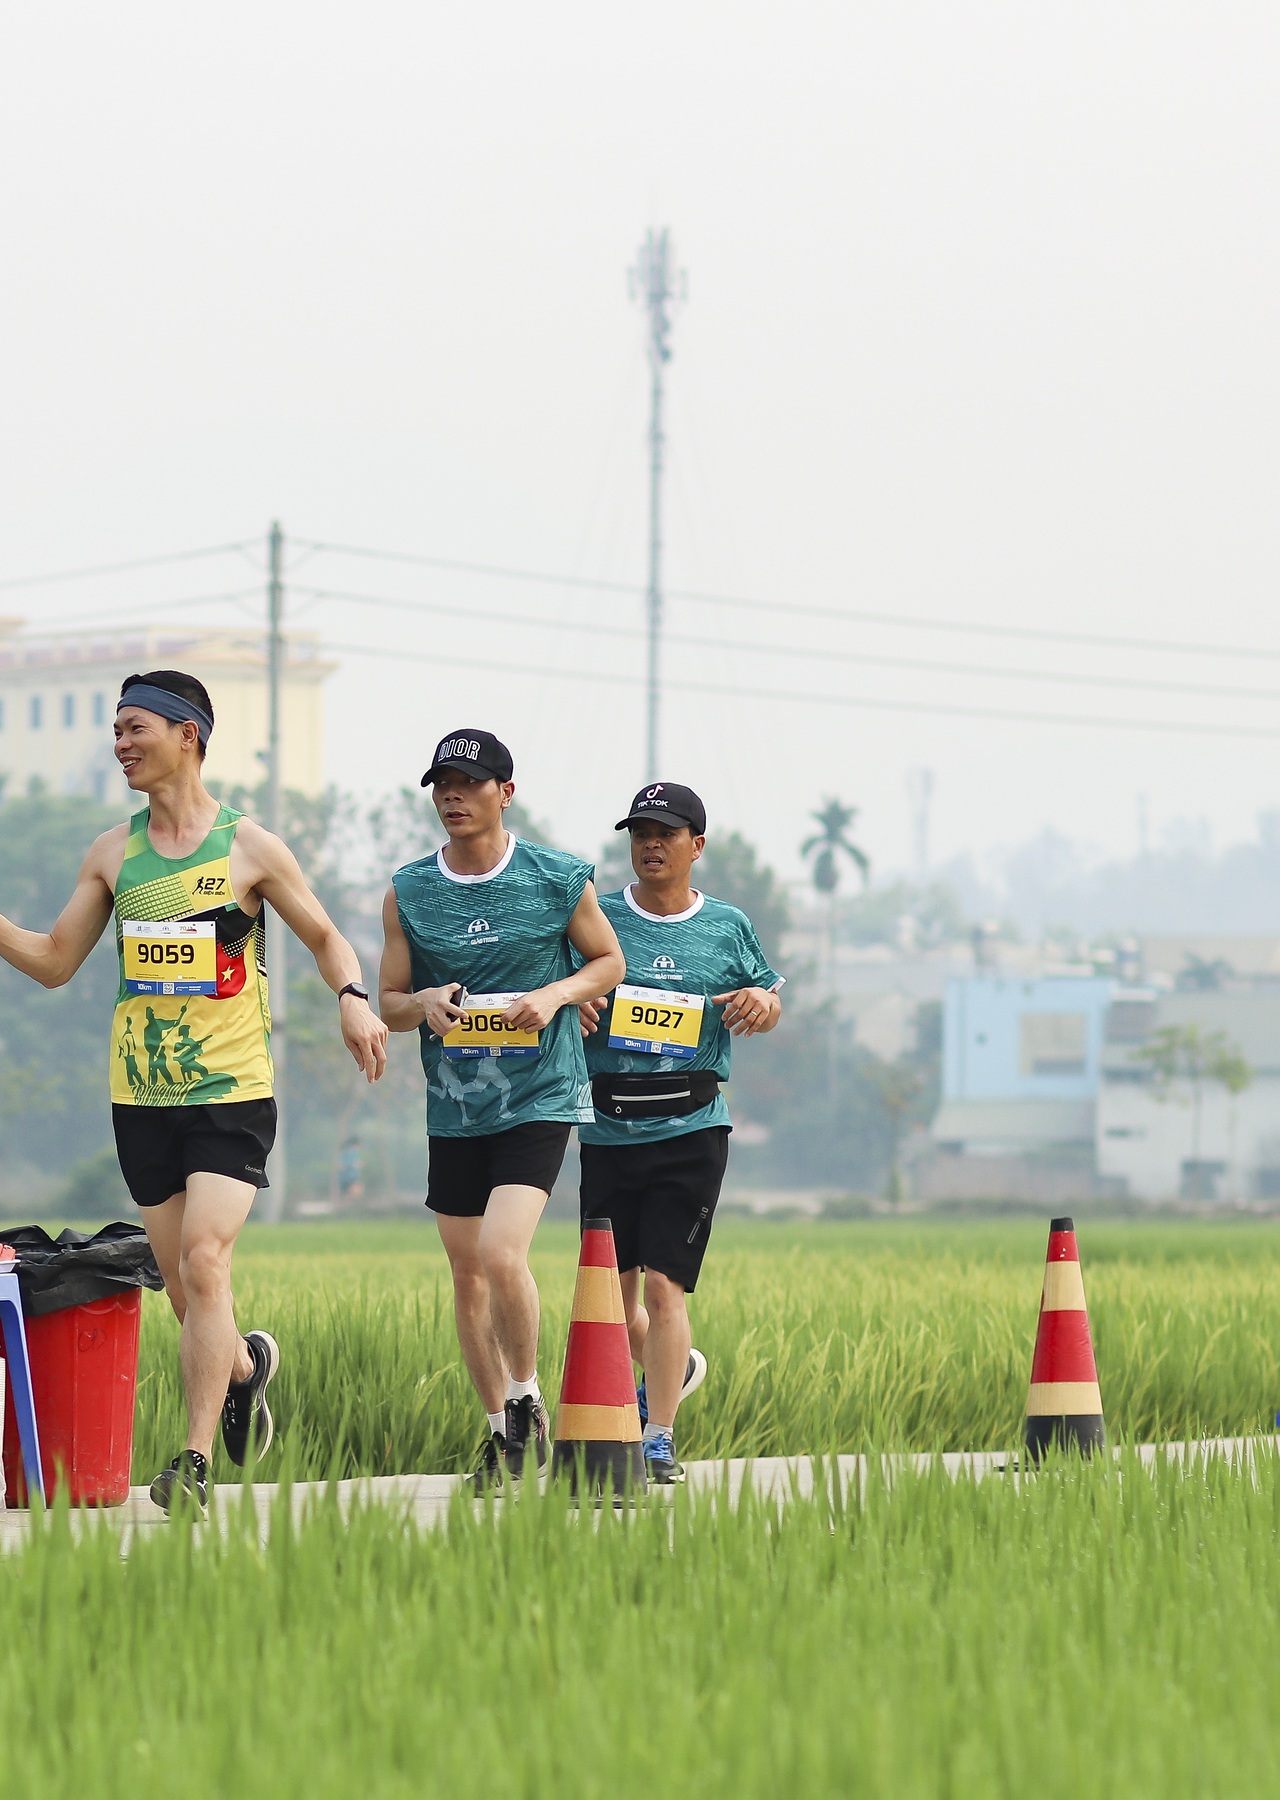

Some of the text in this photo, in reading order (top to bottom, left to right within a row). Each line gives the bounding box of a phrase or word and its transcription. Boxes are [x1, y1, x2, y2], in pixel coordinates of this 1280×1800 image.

[438, 738, 481, 762] DIOR
[637, 800, 669, 808] TIK TOK
[204, 878, 226, 890] 27
[137, 943, 195, 964] 9059
[137, 983, 153, 991] 10km
[631, 1005, 684, 1029] 9027
[624, 1039, 641, 1048] 10km
